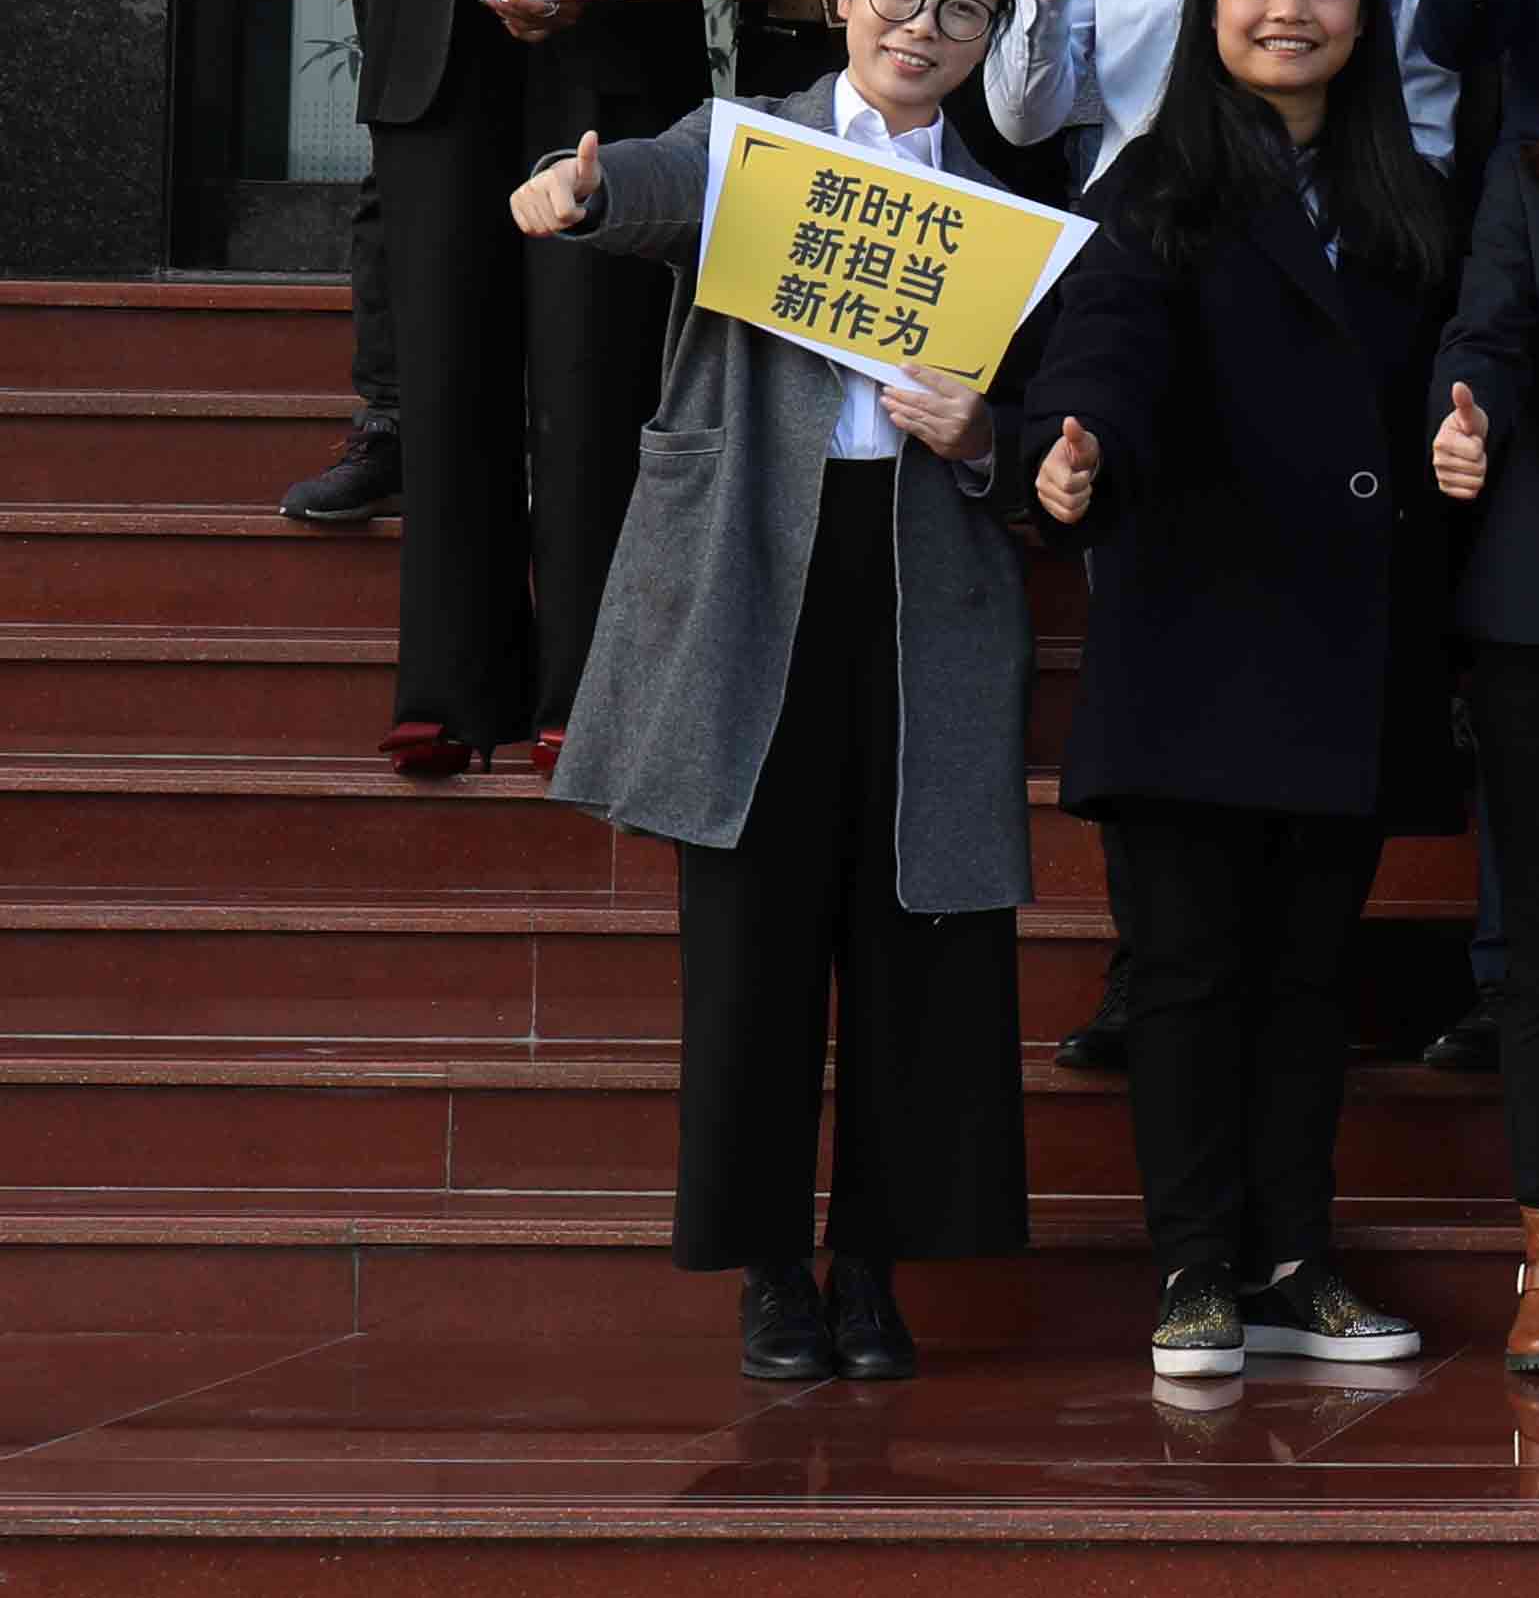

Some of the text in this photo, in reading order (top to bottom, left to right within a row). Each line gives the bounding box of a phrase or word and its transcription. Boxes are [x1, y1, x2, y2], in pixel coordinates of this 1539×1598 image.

[804, 168, 965, 255] 新时代
[788, 220, 948, 307] 新担当
[769, 273, 930, 357] 新作为
